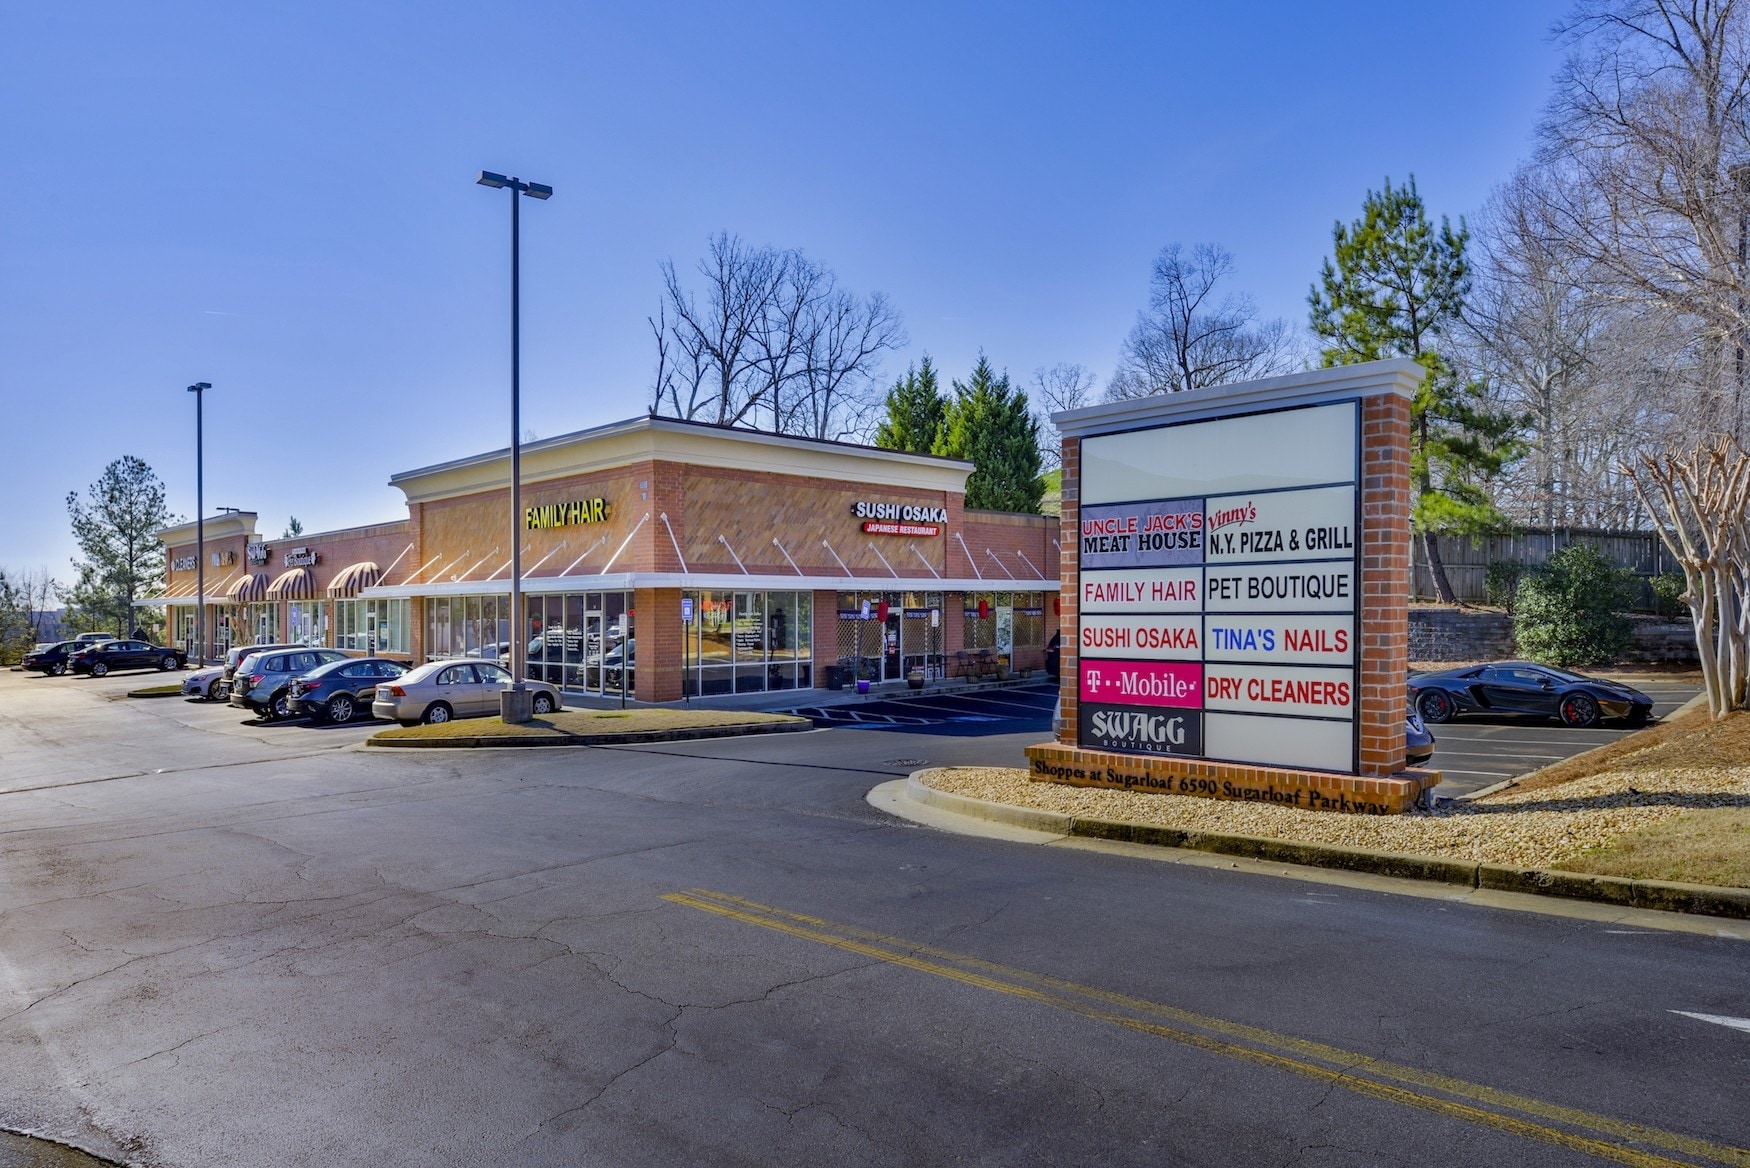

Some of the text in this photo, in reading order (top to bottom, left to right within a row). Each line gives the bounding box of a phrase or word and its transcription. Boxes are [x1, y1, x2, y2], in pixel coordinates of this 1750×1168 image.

[525, 498, 606, 530] FAMILY HAIR
[856, 501, 948, 524] SUSHI OSAKA
[1082, 513, 1203, 536] UNCLE JACK'S
[1208, 501, 1256, 530] Vinny's
[867, 523, 937, 536] JAPANESE RESTAURANT
[1083, 530, 1201, 554] MEAT HOUSE
[1210, 526, 1353, 555] N.Y. PIZZA & GRILL
[1085, 580, 1197, 602] FAMILY HAIR
[1209, 574, 1349, 600] PET BOUTIQUE
[1082, 627, 1199, 649] SUSHI OSAKA
[1212, 628, 1348, 653] TINA'S NAILS
[1207, 676, 1350, 706] DRY CLEANERS
[1091, 710, 1185, 745] SWAGG
[1103, 739, 1171, 752] BOUTIQUE
[1035, 760, 1390, 816] Shoppes at Sugarloaf 6590 Sugarloaf Parkway
